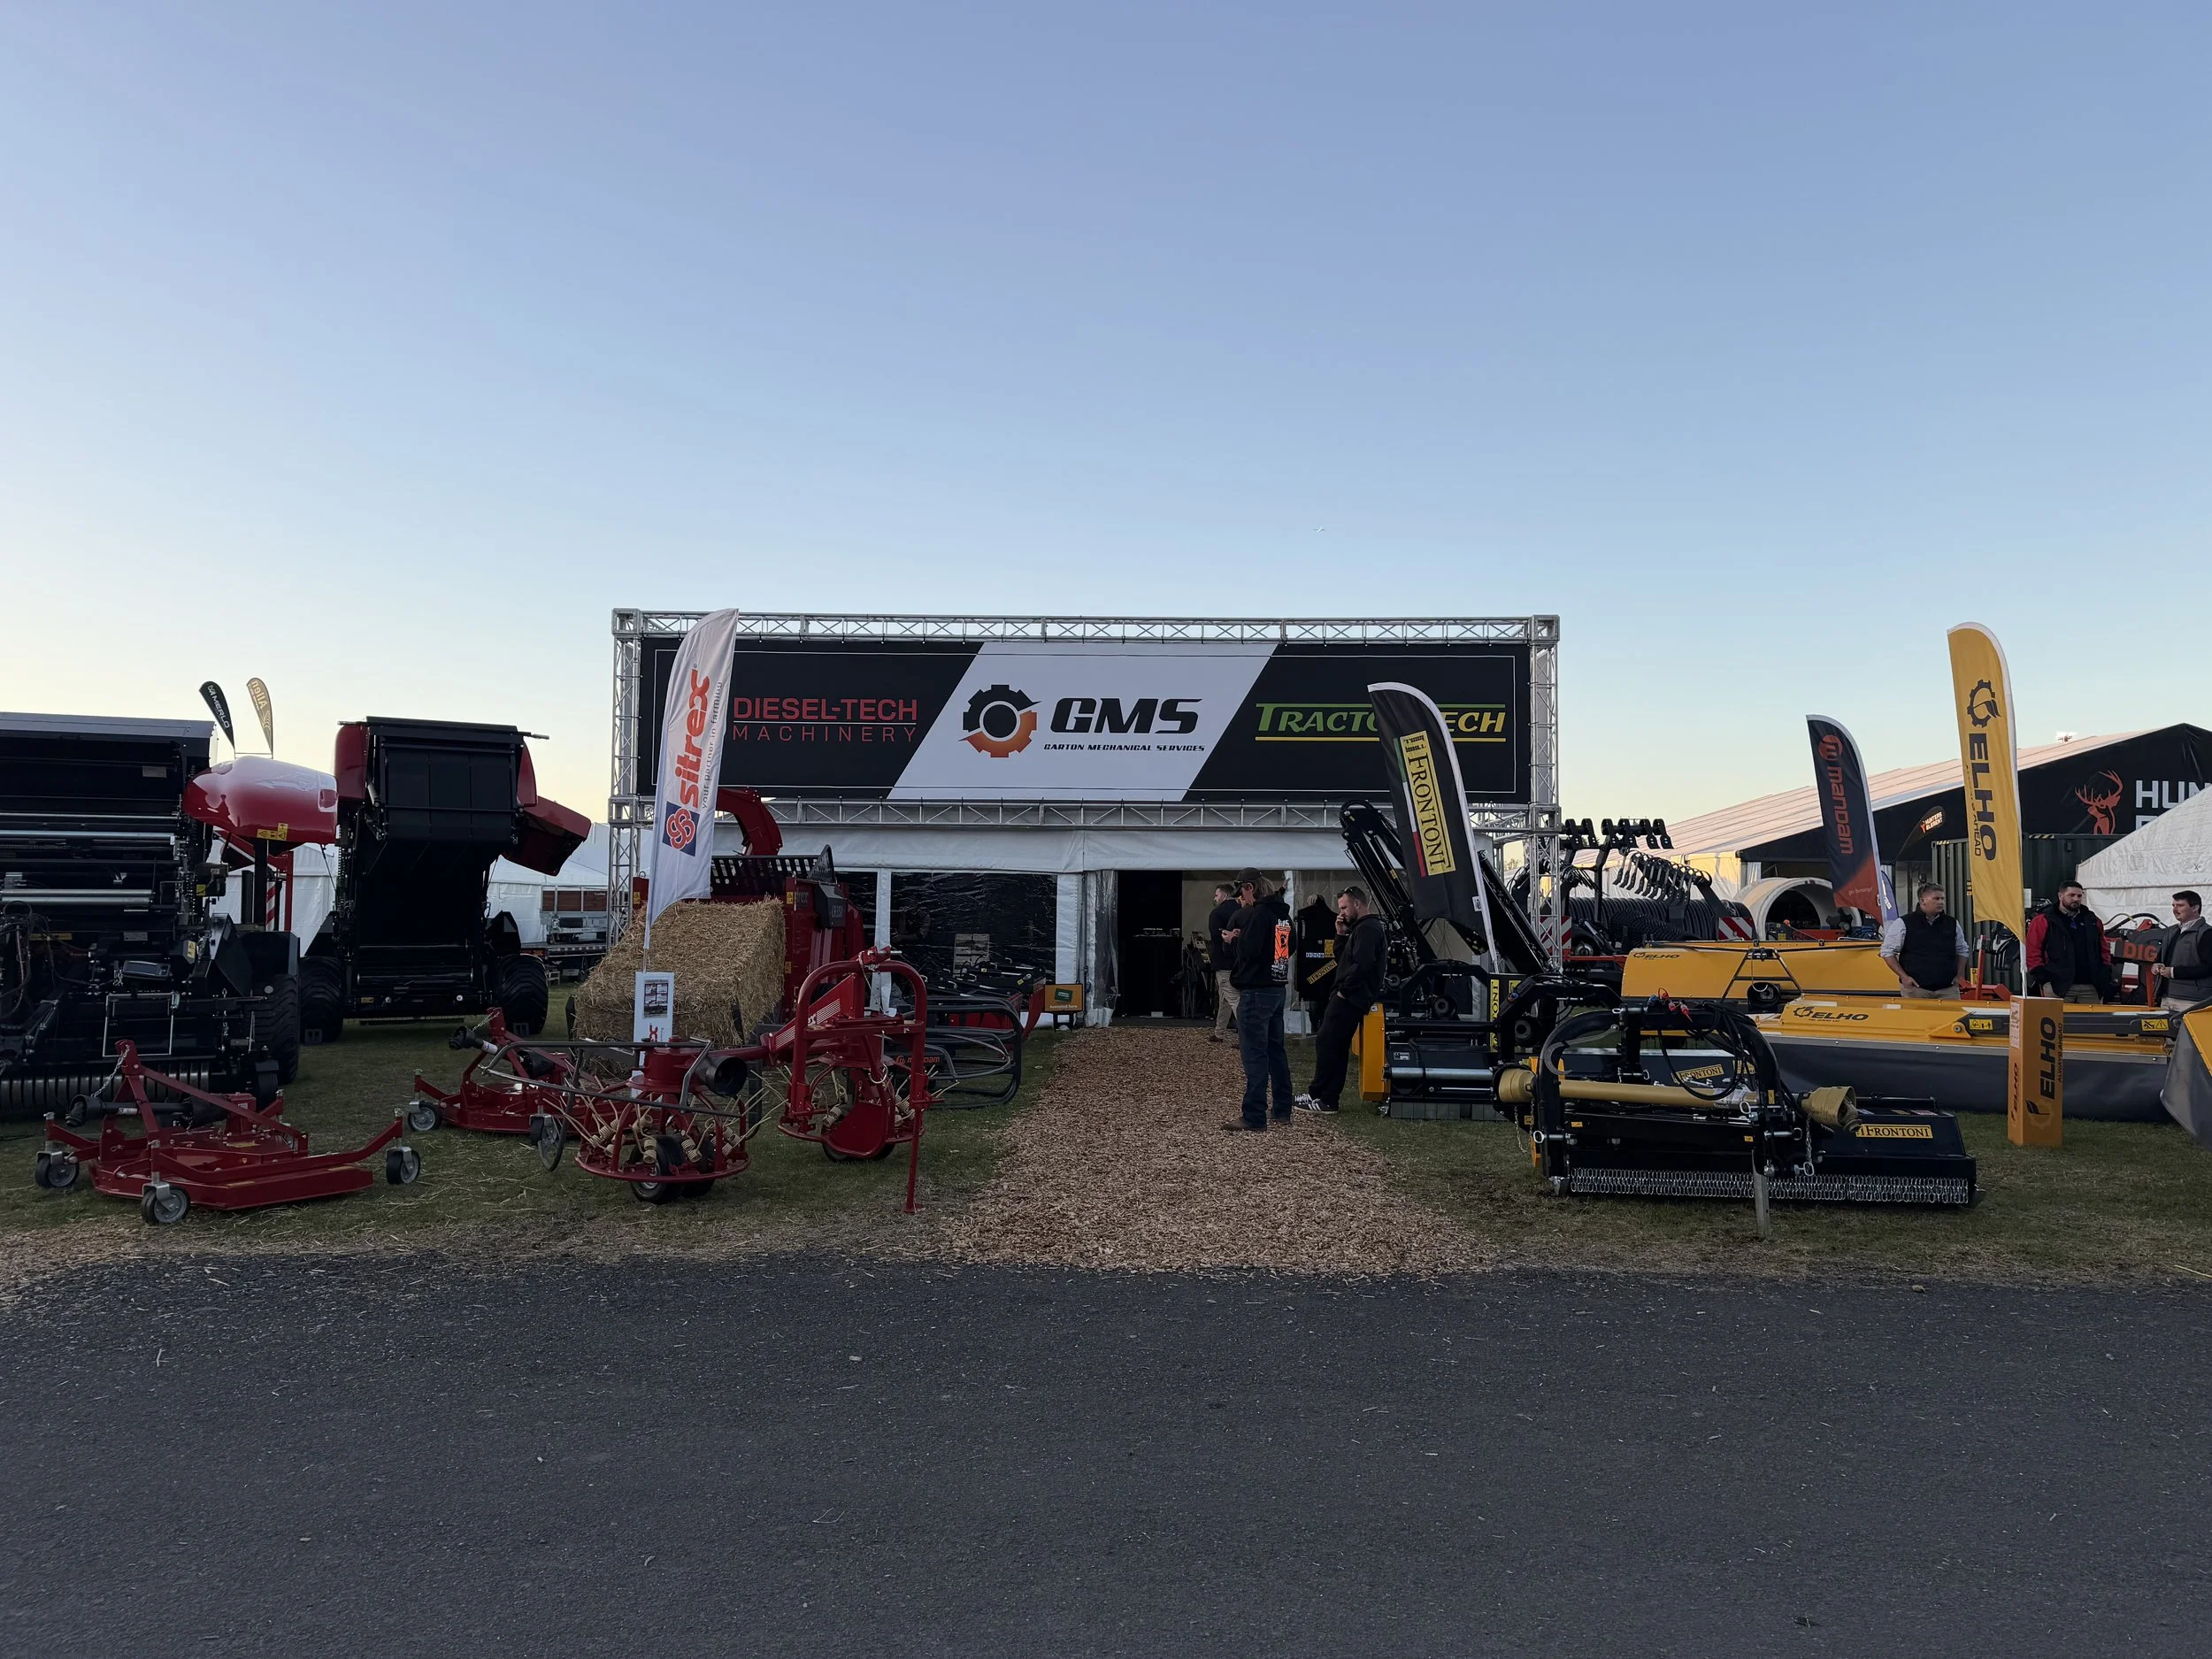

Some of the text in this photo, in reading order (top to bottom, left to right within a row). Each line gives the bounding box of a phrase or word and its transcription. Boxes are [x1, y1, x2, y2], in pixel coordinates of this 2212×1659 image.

[212, 695, 230, 728] MERLO
[711, 681, 723, 726] farming
[733, 697, 918, 721] DIESEL-TECH
[1050, 697, 1203, 734] GMS
[675, 668, 710, 809] sitrex
[733, 725, 917, 742] MACHINERY
[1408, 752, 1451, 869] FRONTONI
[1969, 733, 1997, 861] ELHO
[1811, 1011, 1869, 1021] ELHO
[2040, 1017, 2056, 1100] ELHO
[1864, 1125, 1930, 1138] FRONTONI
